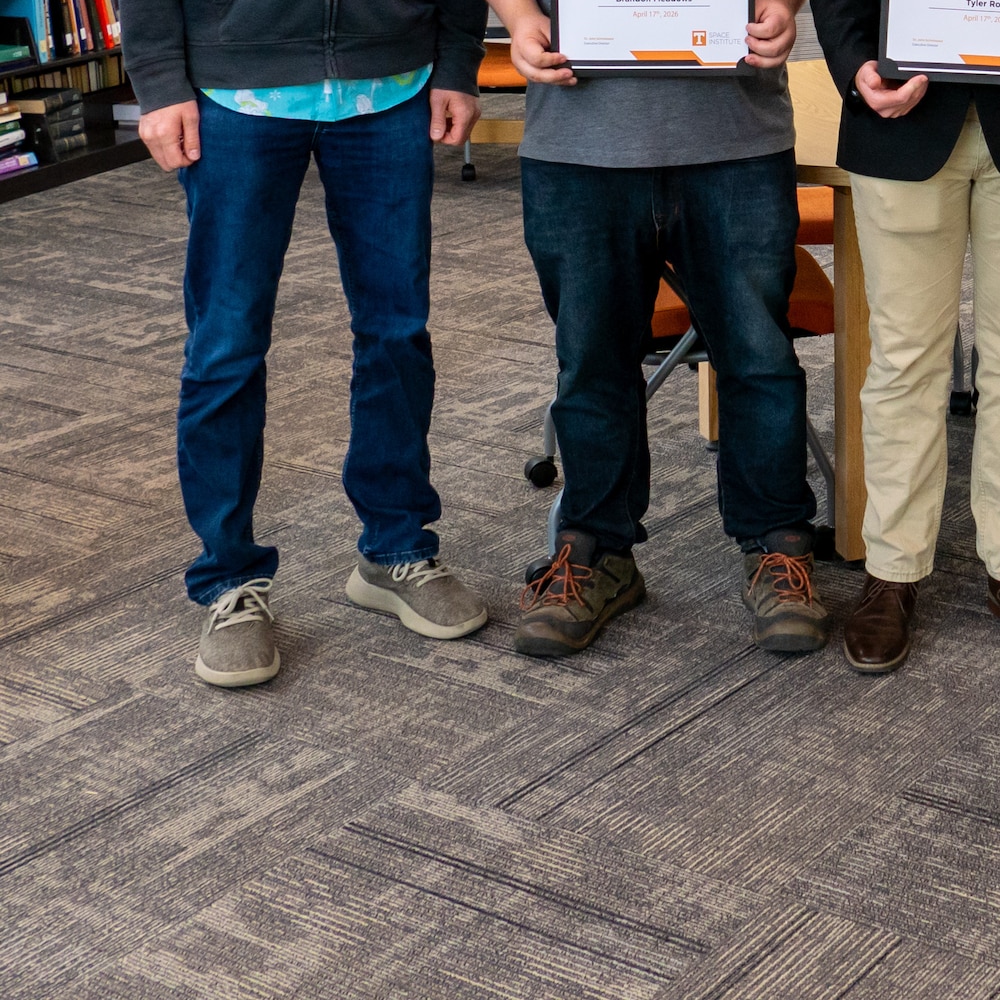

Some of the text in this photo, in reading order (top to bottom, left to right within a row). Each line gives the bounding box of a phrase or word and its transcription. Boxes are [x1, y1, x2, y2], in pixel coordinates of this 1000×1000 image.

[966, 0, 987, 8] Tyler
[633, 11, 648, 19] April
[963, 14, 979, 22] April
